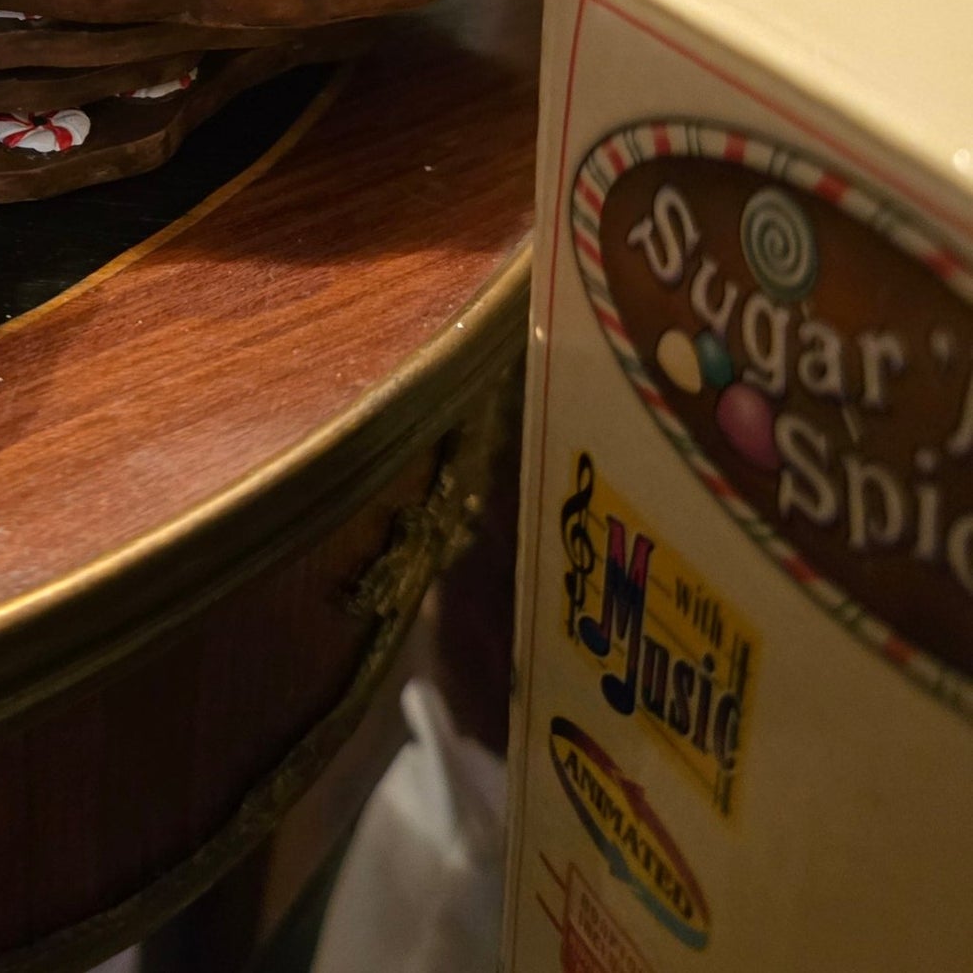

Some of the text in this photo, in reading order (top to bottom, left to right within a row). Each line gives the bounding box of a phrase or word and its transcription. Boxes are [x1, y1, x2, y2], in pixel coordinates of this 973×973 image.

[627, 184, 906, 407] Sugar
[578, 513, 743, 770] Music
[675, 576, 724, 649] with
[563, 749, 694, 920] ANIMATED
